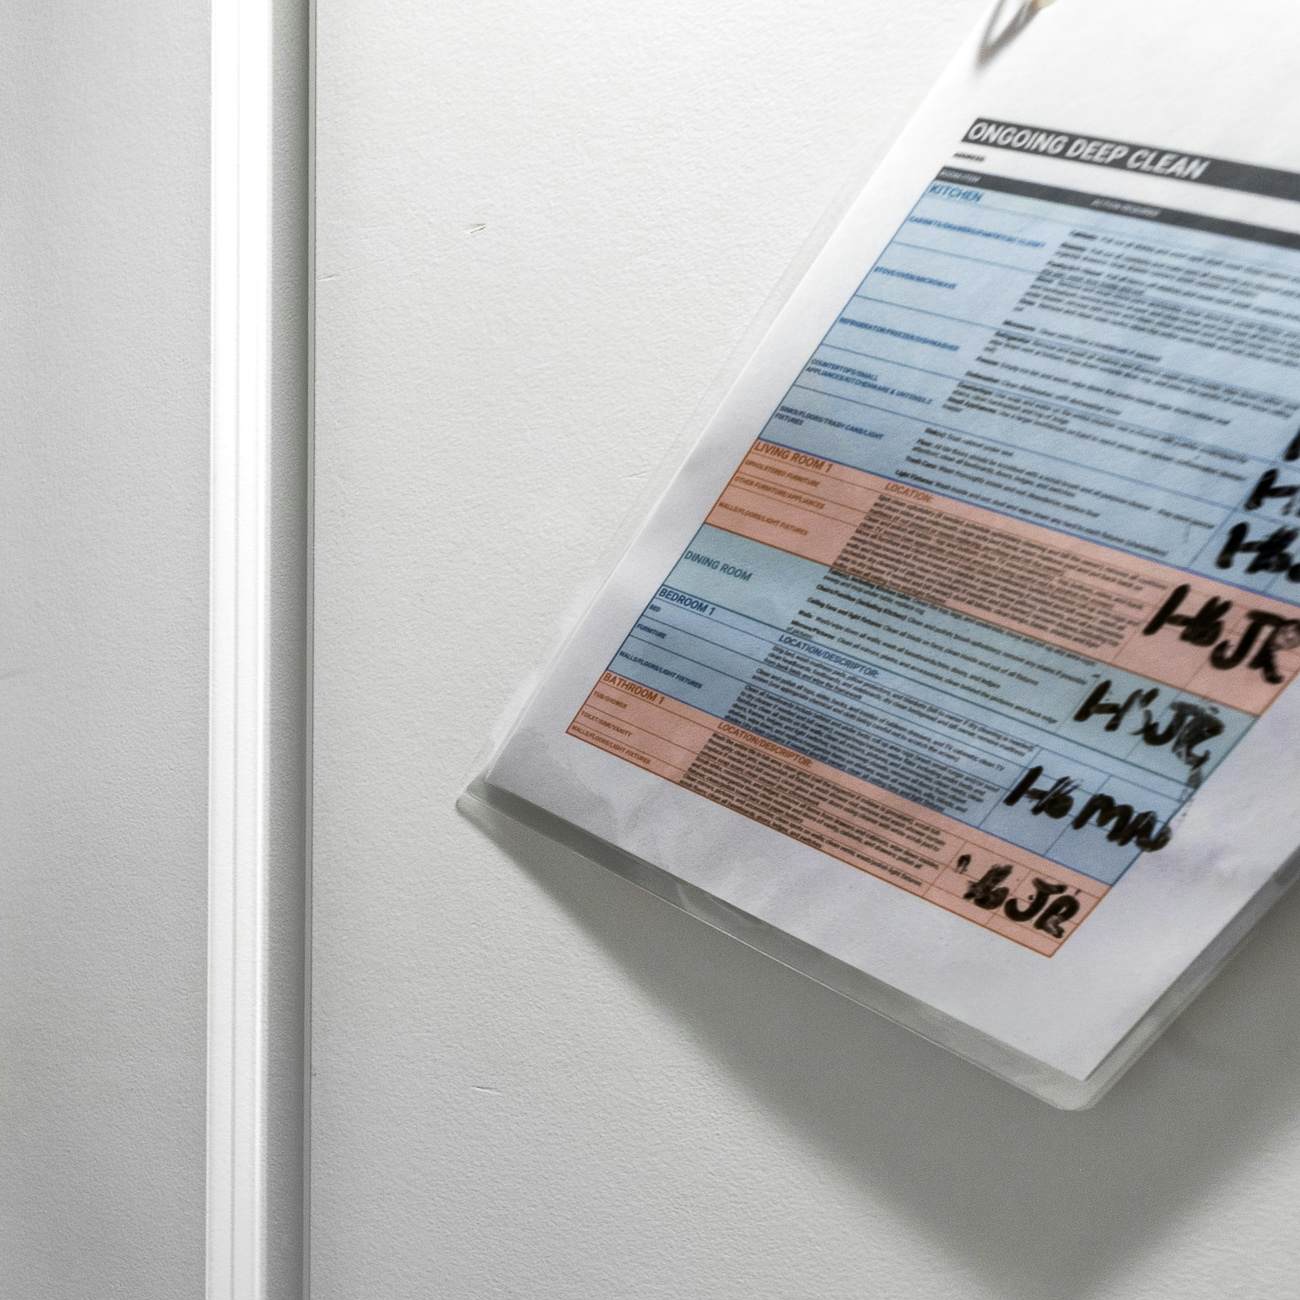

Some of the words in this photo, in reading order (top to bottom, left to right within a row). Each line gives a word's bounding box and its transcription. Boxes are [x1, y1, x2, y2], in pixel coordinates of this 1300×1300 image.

[968, 122, 1070, 156] ONGOING
[1067, 138, 1130, 163] DEEP
[1127, 149, 1210, 180] CLEAN
[928, 184, 984, 202] KITCHEN
[753, 441, 791, 460] LIVING
[788, 451, 826, 470] ROOM
[824, 462, 834, 473] 1
[682, 548, 718, 570] DINING
[714, 560, 754, 583] ROOM
[657, 587, 709, 613] BEDROOM
[707, 606, 716, 616] 1
[777, 633, 881, 679] LOCATION/DESCRIPTOR:
[602, 672, 659, 702] BATHROOM
[657, 696, 665, 704] 1
[716, 721, 814, 768] LOCATION/DESCRIPTOR:
